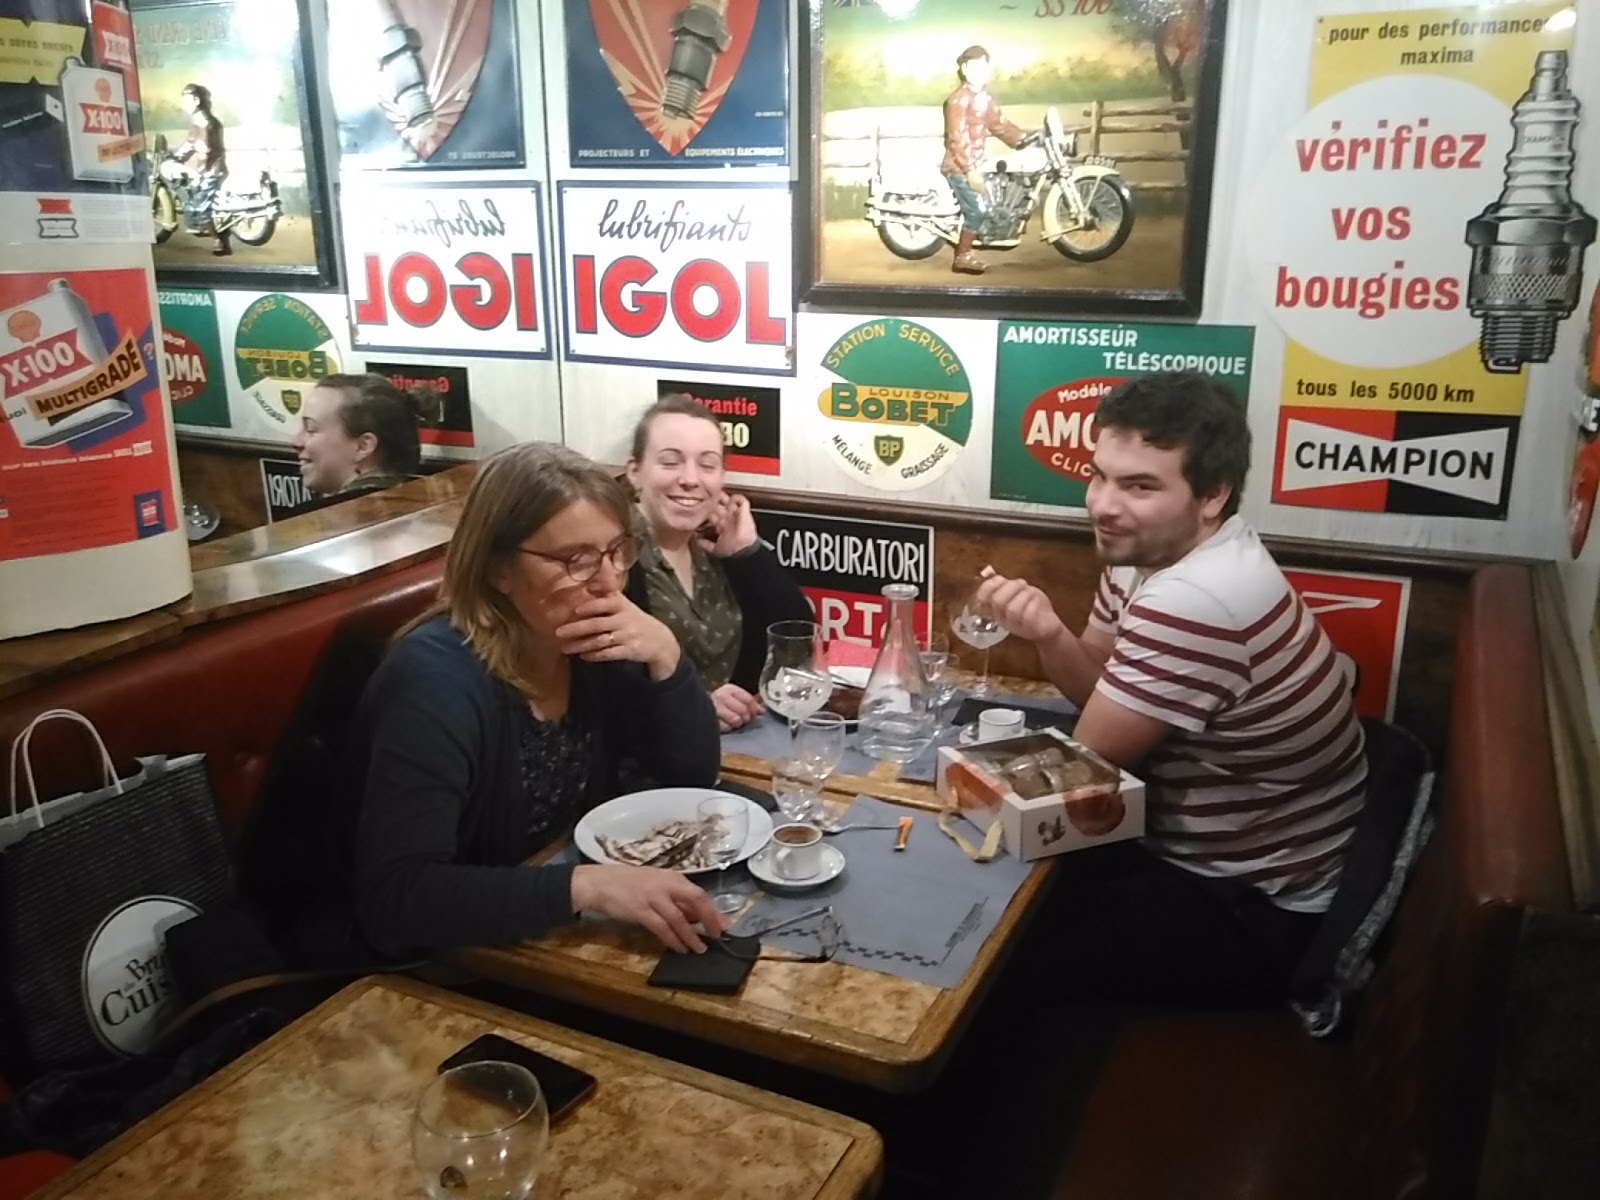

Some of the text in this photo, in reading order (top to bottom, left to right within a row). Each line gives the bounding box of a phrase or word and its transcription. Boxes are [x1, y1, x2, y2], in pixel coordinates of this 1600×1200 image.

[1328, 24, 1369, 45] pour
[1378, 19, 1409, 37] des
[1400, 47, 1474, 65] maxima
[578, 149, 635, 158] PROJECTEURS
[640, 149, 651, 158] ET
[1296, 118, 1487, 172] vérifiez
[598, 198, 752, 253] lubrifiants
[1331, 206, 1411, 241] vos
[572, 254, 787, 347] IGOL
[1275, 260, 1460, 319] bougies
[3, 341, 75, 388] X-100
[827, 322, 960, 376] STATION SERVICE
[1103, 351, 1246, 376] TÉLÉSCOPIQUE
[35, 337, 142, 415] MULTIGRADE
[869, 388, 950, 401] LOUISON
[1297, 379, 1475, 403] tous les 5000 km
[831, 382, 956, 426] BOBET
[878, 440, 901, 458] BP
[901, 442, 950, 479] GRAISSAGE
[1295, 441, 1494, 480] CHAMPION
[776, 529, 925, 584] CARBURATORI
